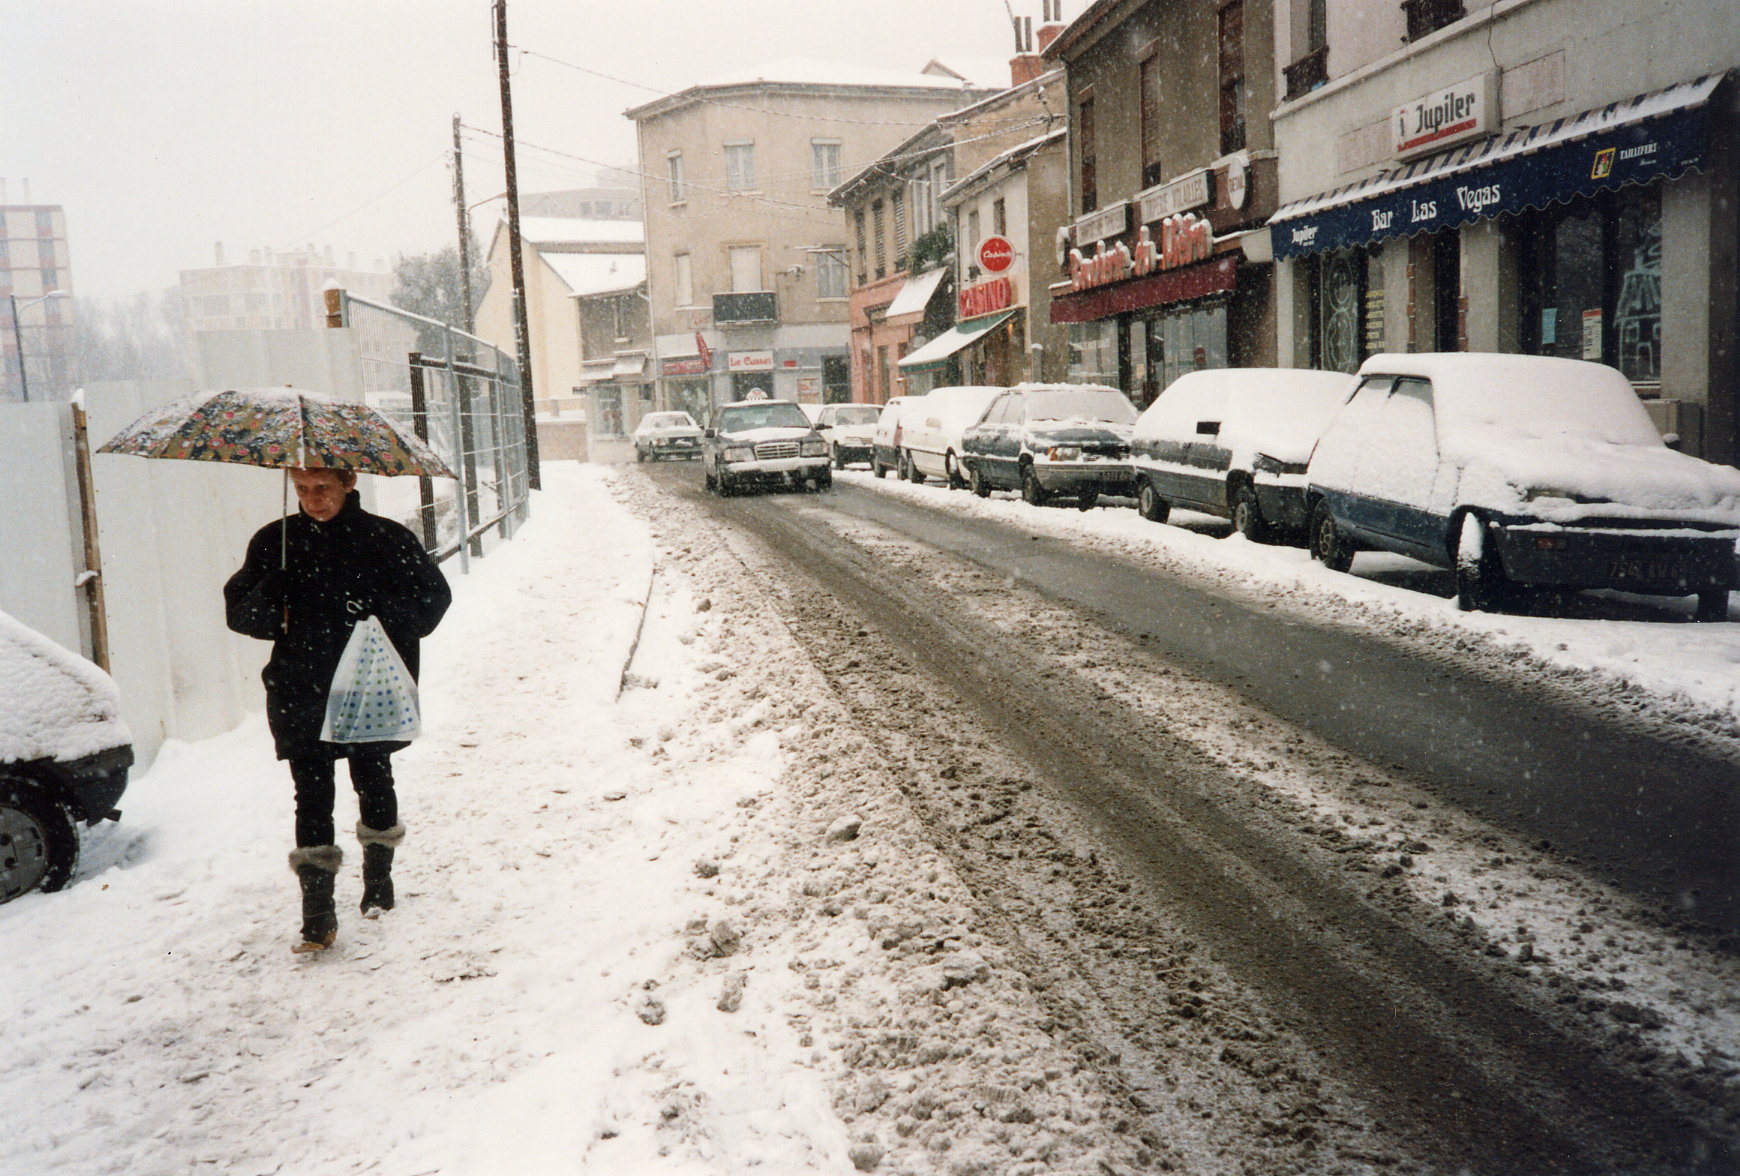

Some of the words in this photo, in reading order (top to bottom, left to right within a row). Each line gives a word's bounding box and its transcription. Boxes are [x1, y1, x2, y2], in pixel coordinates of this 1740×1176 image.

[1415, 92, 1475, 135] Jupiler
[1371, 208, 1393, 231] Bar
[1411, 200, 1437, 222] Las
[1456, 184, 1500, 213] Vegas
[983, 250, 1011, 259] Casino
[959, 277, 1008, 317] CASINO
[730, 357, 741, 367] Le
